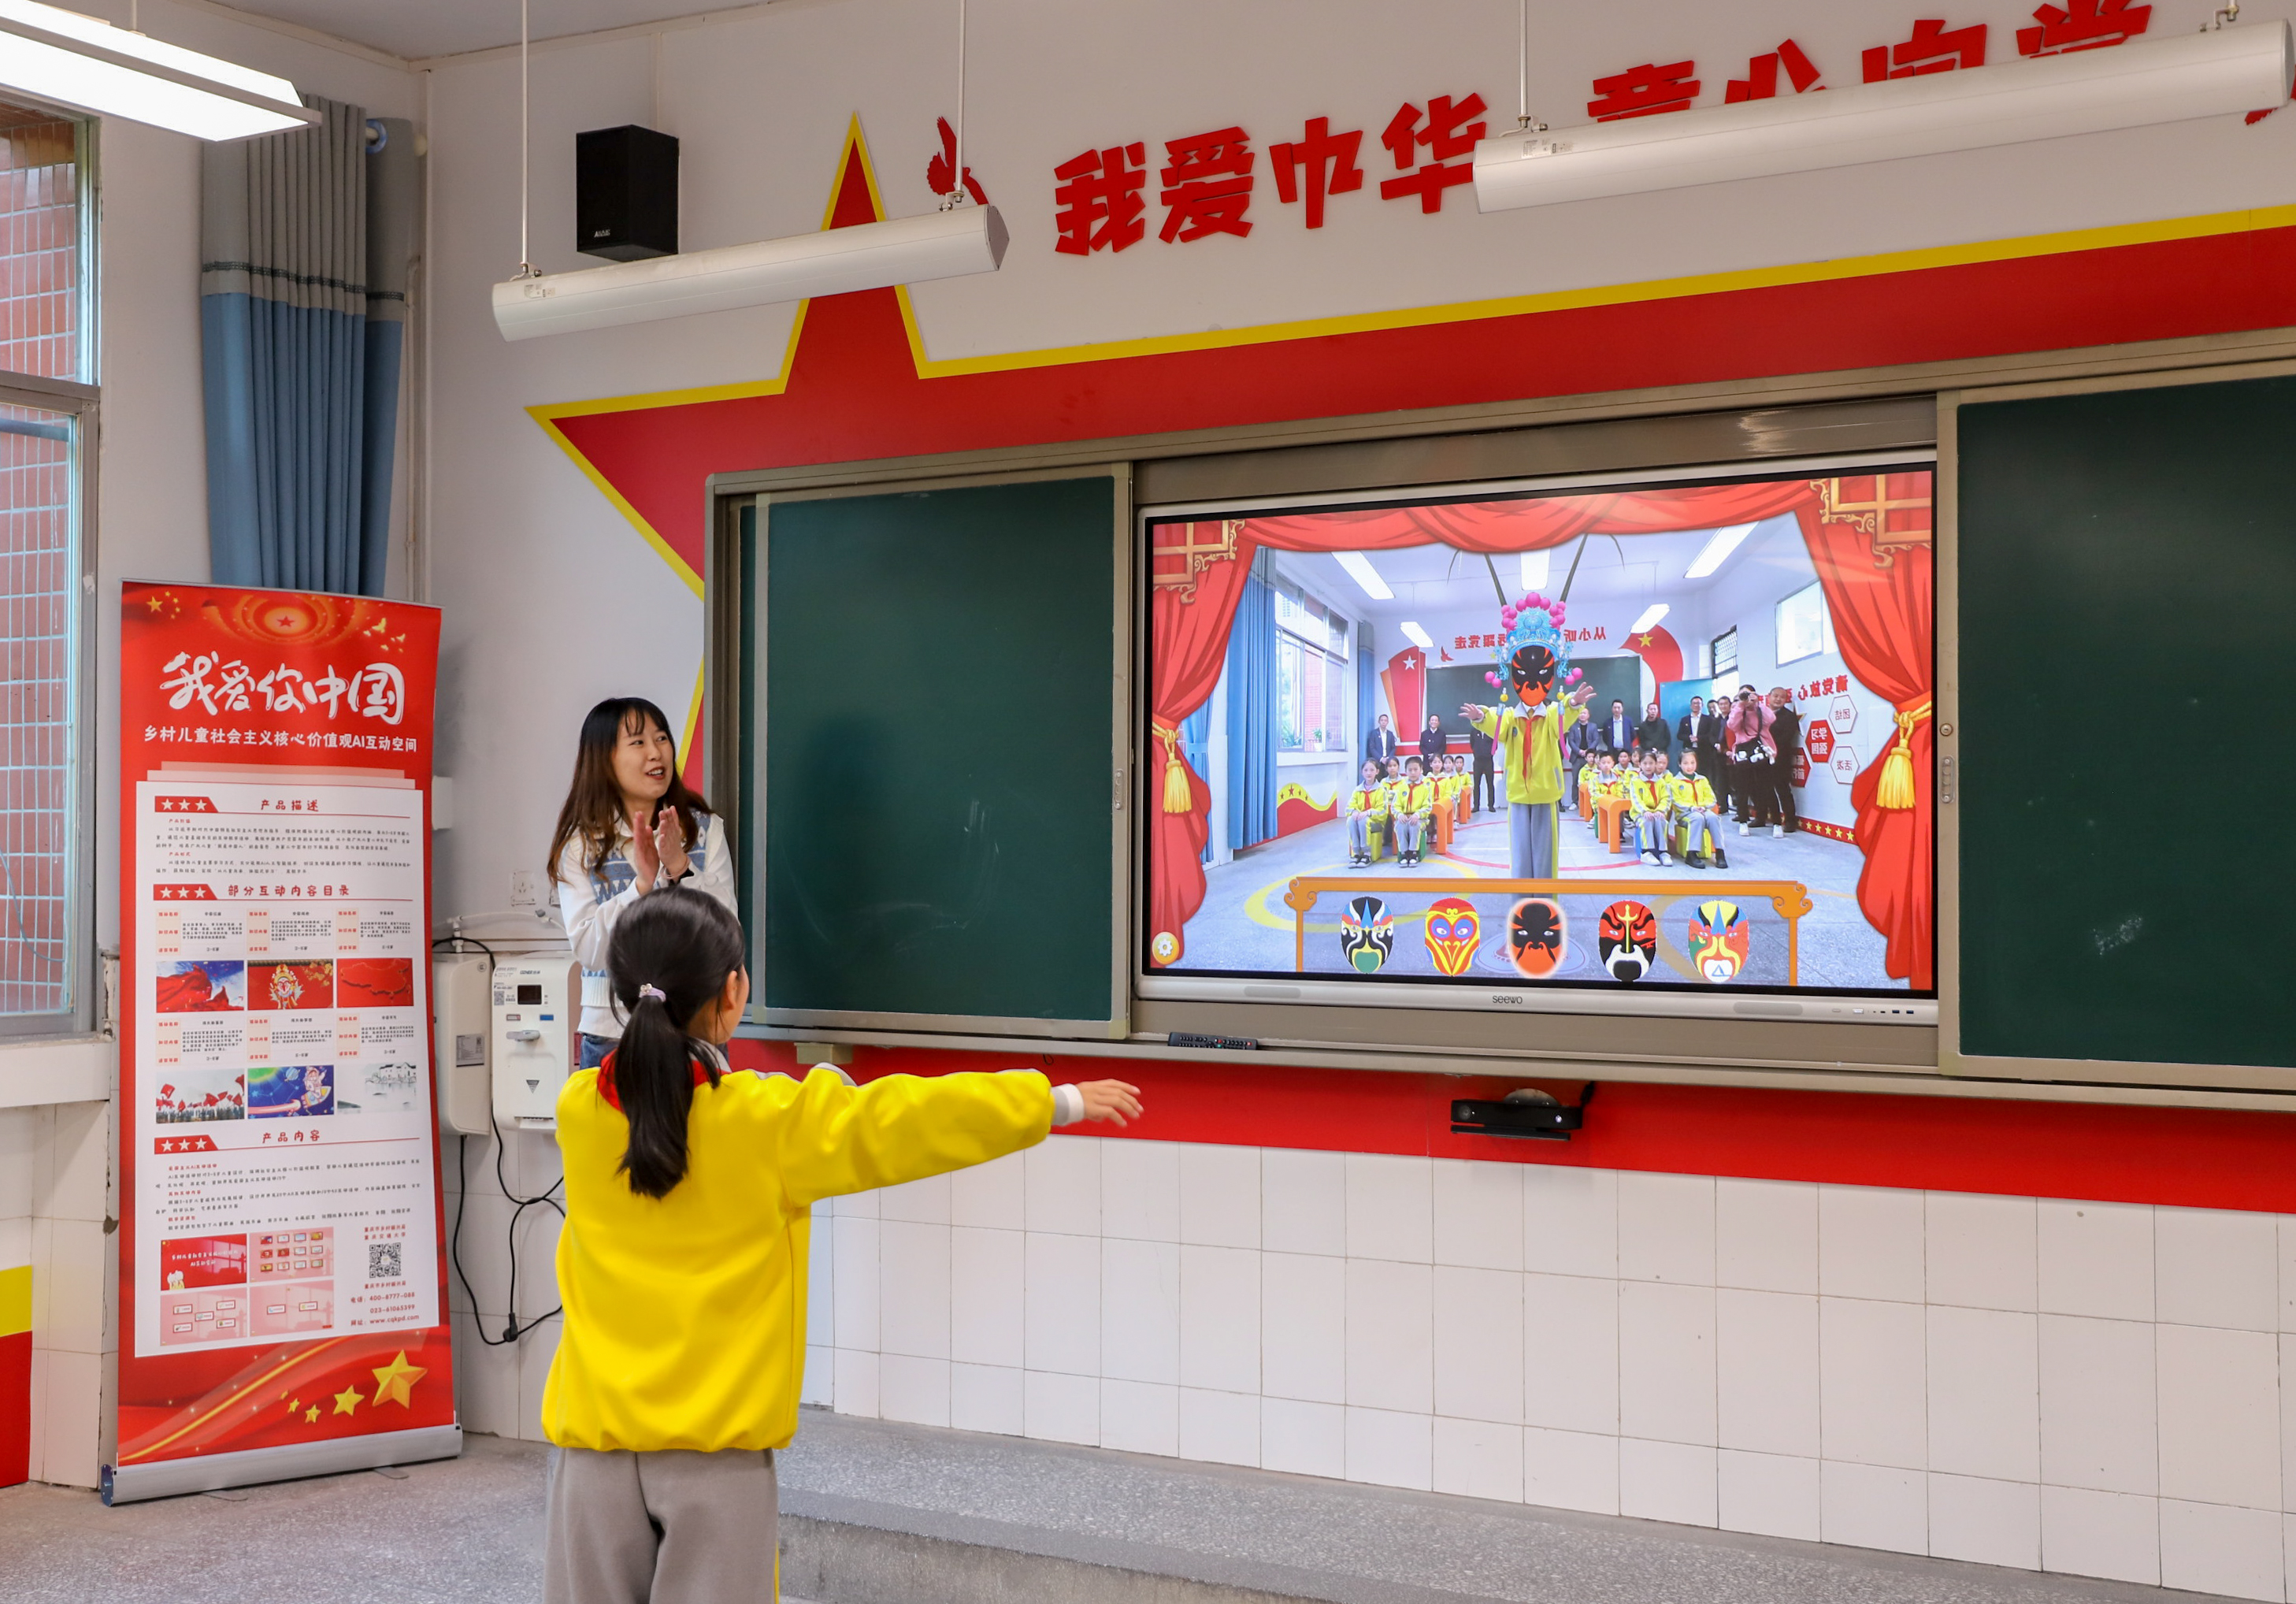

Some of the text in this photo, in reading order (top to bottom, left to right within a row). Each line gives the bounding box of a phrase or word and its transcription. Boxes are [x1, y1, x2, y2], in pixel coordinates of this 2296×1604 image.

[159, 651, 406, 725] 我爱你中国
[144, 725, 417, 752] 乡村儿童社会主义核心价值观AI互动空间
[261, 799, 319, 811] 产品描述
[228, 885, 350, 897] 部分互动内容目录
[262, 1130, 320, 1144] 产品内容
